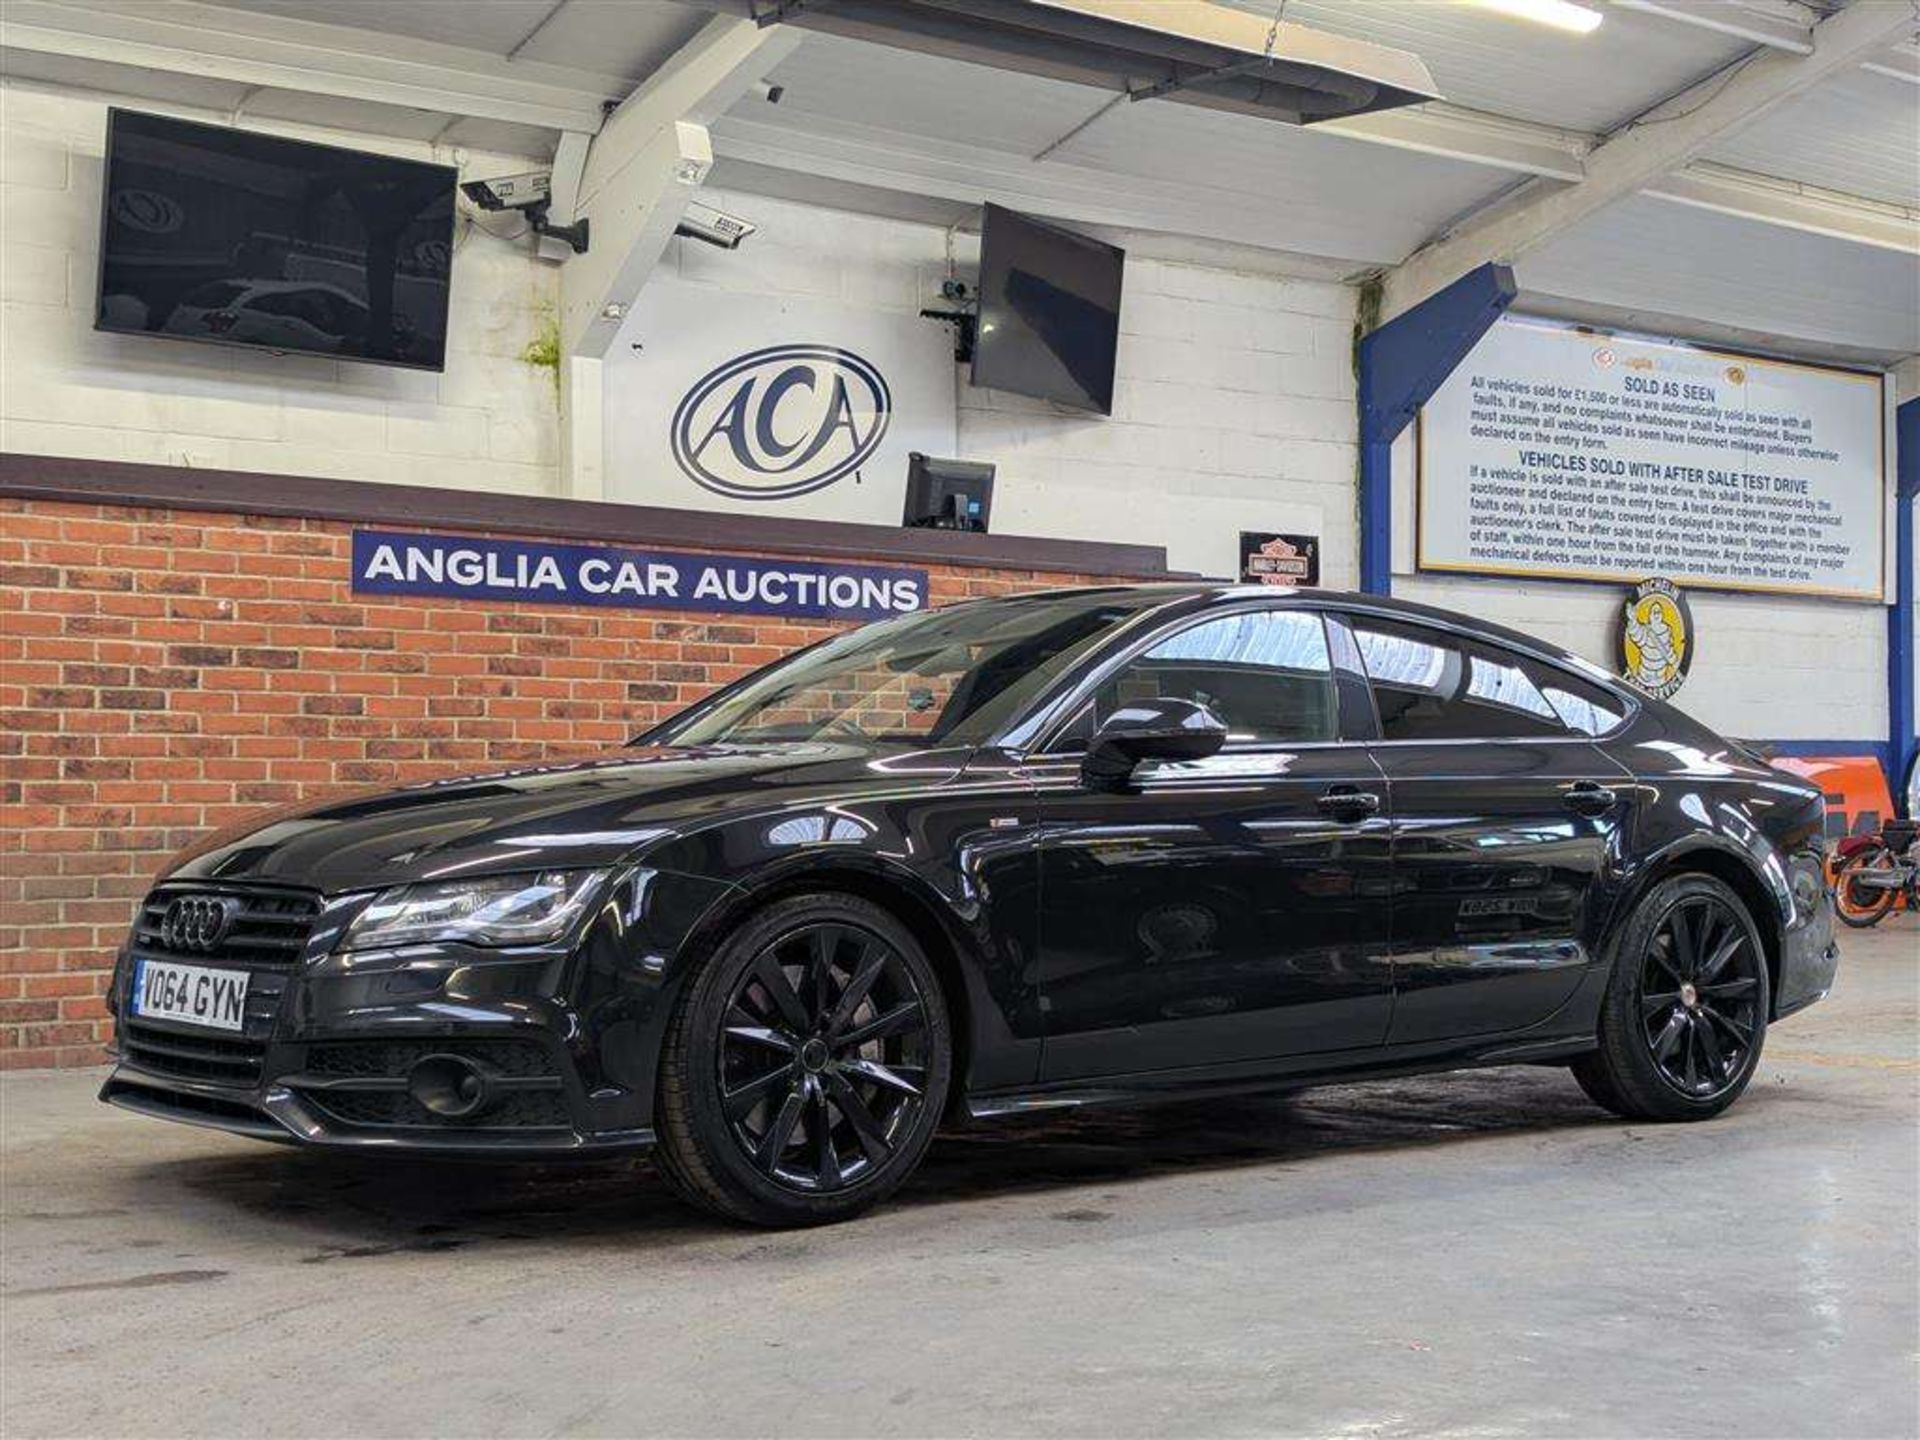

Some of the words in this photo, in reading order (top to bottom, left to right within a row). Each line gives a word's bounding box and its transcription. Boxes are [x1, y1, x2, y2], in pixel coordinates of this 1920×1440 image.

[1471, 376, 1485, 388] All
[1487, 378, 1530, 394] vehicles
[1533, 384, 1556, 397] sold
[1558, 387, 1572, 399] for
[1575, 389, 1607, 404] £1,500
[1609, 396, 1620, 405] or
[1622, 395, 1642, 408] less
[1644, 400, 1660, 410] are
[1724, 408, 1744, 421] sold
[1746, 413, 1757, 422] as
[1759, 415, 1779, 425] seen
[1782, 416, 1799, 428] with
[1802, 418, 1812, 429] all
[1625, 377, 1660, 395] SOLD
[1663, 382, 1679, 398] AS
[1683, 385, 1715, 402] SEEN
[691, 363, 864, 473] ACA
[1471, 408, 1497, 422] must
[1500, 414, 1540, 427] assume
[1543, 417, 1555, 429] all
[1558, 418, 1599, 434] vehicles
[1601, 424, 1623, 436] sold
[1624, 428, 1636, 438] as
[1638, 430, 1661, 441] seen
[1663, 431, 1685, 444] have
[1687, 434, 1728, 449] incorrect
[1731, 439, 1765, 455] mileage
[1767, 443, 1795, 456] unless
[1471, 424, 1517, 440] declared
[1519, 432, 1532, 442] on
[1535, 431, 1551, 444] the
[1554, 433, 1580, 450] entry
[1509, 397, 1517, 408] if
[1542, 401, 1562, 414] and
[1564, 406, 1577, 415] no
[1579, 406, 1633, 425] complaints
[1691, 419, 1713, 432] shall
[1714, 422, 1726, 433] be
[1783, 431, 1812, 446] Buyers
[1470, 465, 1478, 477] If
[1481, 468, 1487, 478] a
[1490, 467, 1527, 481] vehicle
[1529, 471, 1539, 483] is
[1541, 472, 1564, 485] sold
[1566, 475, 1588, 487] with
[1590, 479, 1602, 489] an
[1604, 478, 1627, 491] after
[1629, 481, 1649, 493] sale
[1650, 483, 1669, 495] test
[1699, 488, 1717, 500] this
[1718, 490, 1741, 502] shall
[1742, 492, 1754, 503] be
[1805, 498, 1816, 512] by
[1817, 500, 1831, 510] the
[1519, 450, 1587, 472] VEHICLES
[1590, 458, 1626, 476] SOLD
[1629, 462, 1661, 479] WITH
[1664, 466, 1704, 484] AFTER
[1708, 470, 1739, 487] SALE
[1742, 474, 1771, 490] TEST
[1774, 477, 1808, 494] DRIVE
[1470, 498, 1500, 511] faults
[1530, 505, 1536, 514] a
[1538, 504, 1555, 515] full
[1557, 505, 1574, 517] list
[1575, 507, 1586, 518] of
[1588, 508, 1616, 520] faults
[1618, 511, 1656, 524] covered
[1658, 514, 1667, 525] is
[1669, 515, 1714, 532] displayed
[1715, 519, 1725, 530] in
[1726, 520, 1741, 531] the
[1743, 522, 1768, 533] office
[1771, 524, 1787, 535] and
[1789, 526, 1807, 537] with
[1808, 527, 1822, 538] the
[1471, 482, 1526, 497] auctioneer
[1528, 487, 1548, 499] and
[1550, 489, 1594, 503] declared
[1596, 495, 1609, 505] on
[1610, 495, 1626, 506] the
[1628, 496, 1653, 511] entry
[1682, 501, 1689, 512] A
[1691, 502, 1709, 514] test
[1711, 504, 1734, 516] drive
[1736, 509, 1766, 519] covers
[1768, 510, 1793, 524] major
[1795, 512, 1842, 526] mechanical
[1470, 530, 1482, 541] of
[1513, 533, 1544, 546] within
[1547, 538, 1566, 547] one
[1568, 537, 1591, 549] hour
[1593, 539, 1617, 551] from
[1618, 541, 1634, 552] the
[1636, 542, 1651, 553] fall
[1653, 544, 1663, 554] of
[1665, 545, 1680, 556] the
[1723, 549, 1741, 563] Any
[1743, 551, 1791, 567] complaints
[1793, 555, 1802, 565] of
[1804, 557, 1819, 569] any
[1820, 557, 1844, 570] major
[1471, 514, 1534, 529] auctioneer's
[1568, 522, 1586, 533] The
[1588, 523, 1611, 535] after
[1613, 525, 1633, 537] sale
[1635, 527, 1654, 539] test
[1656, 529, 1680, 541] drive
[1682, 531, 1705, 543] must
[1707, 533, 1718, 544] be
[1751, 537, 1787, 552] together
[1789, 540, 1808, 551] with
[1817, 542, 1850, 554] member
[364, 544, 567, 591] ANGLIA
[578, 558, 679, 598] CAR
[693, 566, 920, 612] AUCTIONS
[1470, 546, 1530, 561] mechanical
[1532, 550, 1570, 563] defects
[1573, 553, 1598, 565] must
[1600, 555, 1612, 566] be
[1614, 556, 1656, 572] reported
[1658, 559, 1686, 571] within
[1688, 563, 1705, 573] one
[1707, 563, 1728, 574] hour
[1730, 564, 1752, 576] from
[1753, 566, 1768, 577] the
[1770, 567, 1786, 578] test
[194, 975, 244, 1022] GYN
